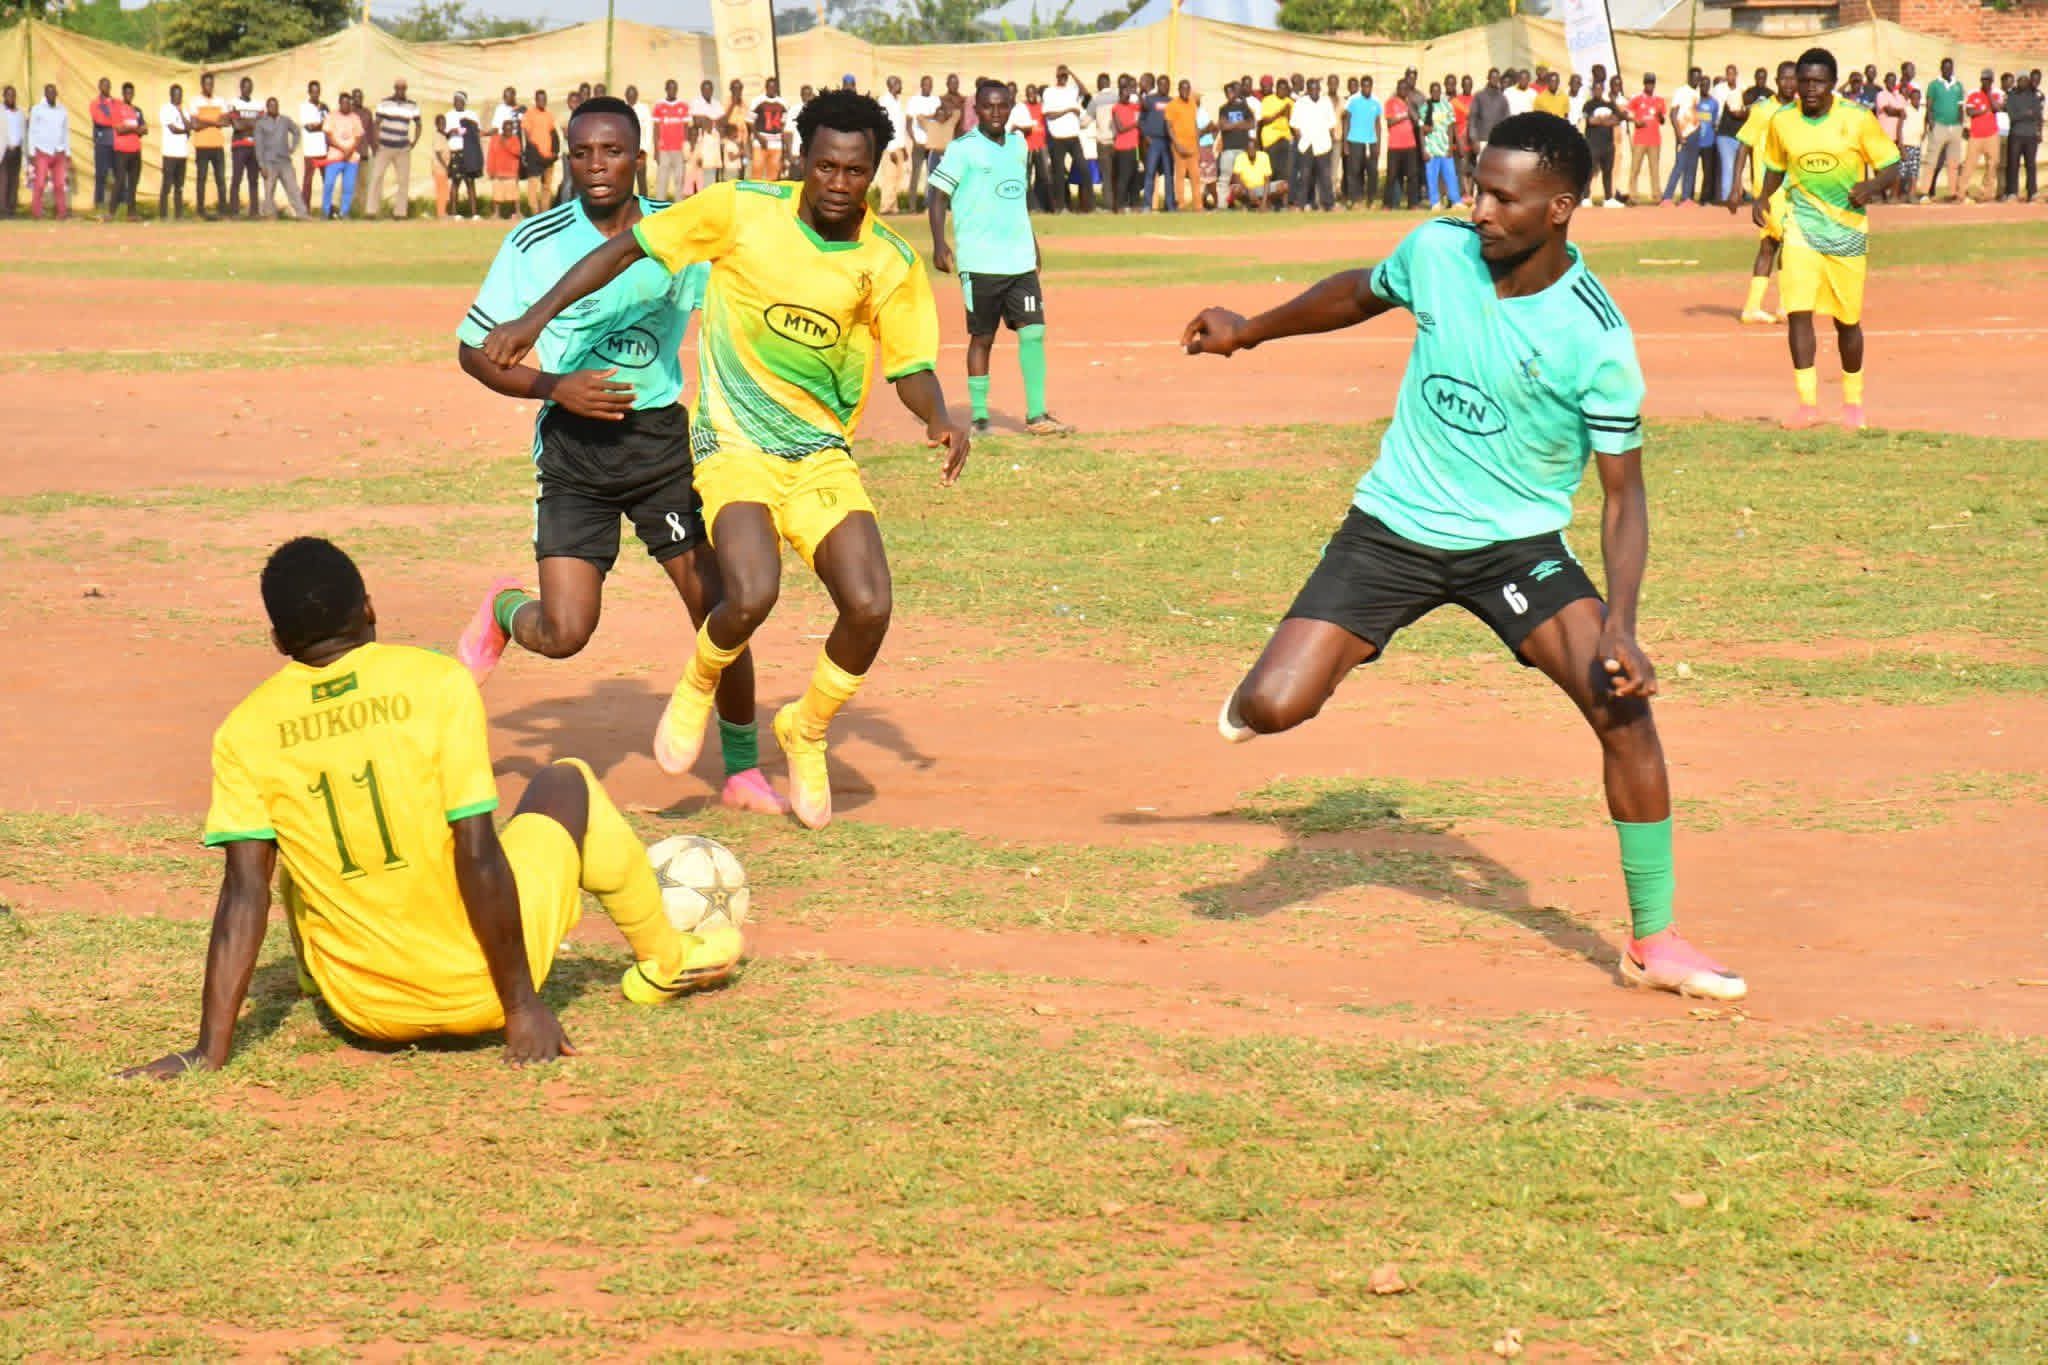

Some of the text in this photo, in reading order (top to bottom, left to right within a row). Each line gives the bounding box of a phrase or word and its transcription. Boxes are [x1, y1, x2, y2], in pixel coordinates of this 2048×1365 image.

[1806, 159, 1829, 167] MTN
[1024, 295, 1036, 312] 11
[784, 312, 827, 338] MTN
[608, 336, 648, 356] MTN
[1437, 388, 1486, 423] MTN
[665, 511, 686, 542] 8
[1503, 582, 1528, 615] 6
[277, 692, 413, 750] BUKONO
[307, 759, 409, 881] 11
